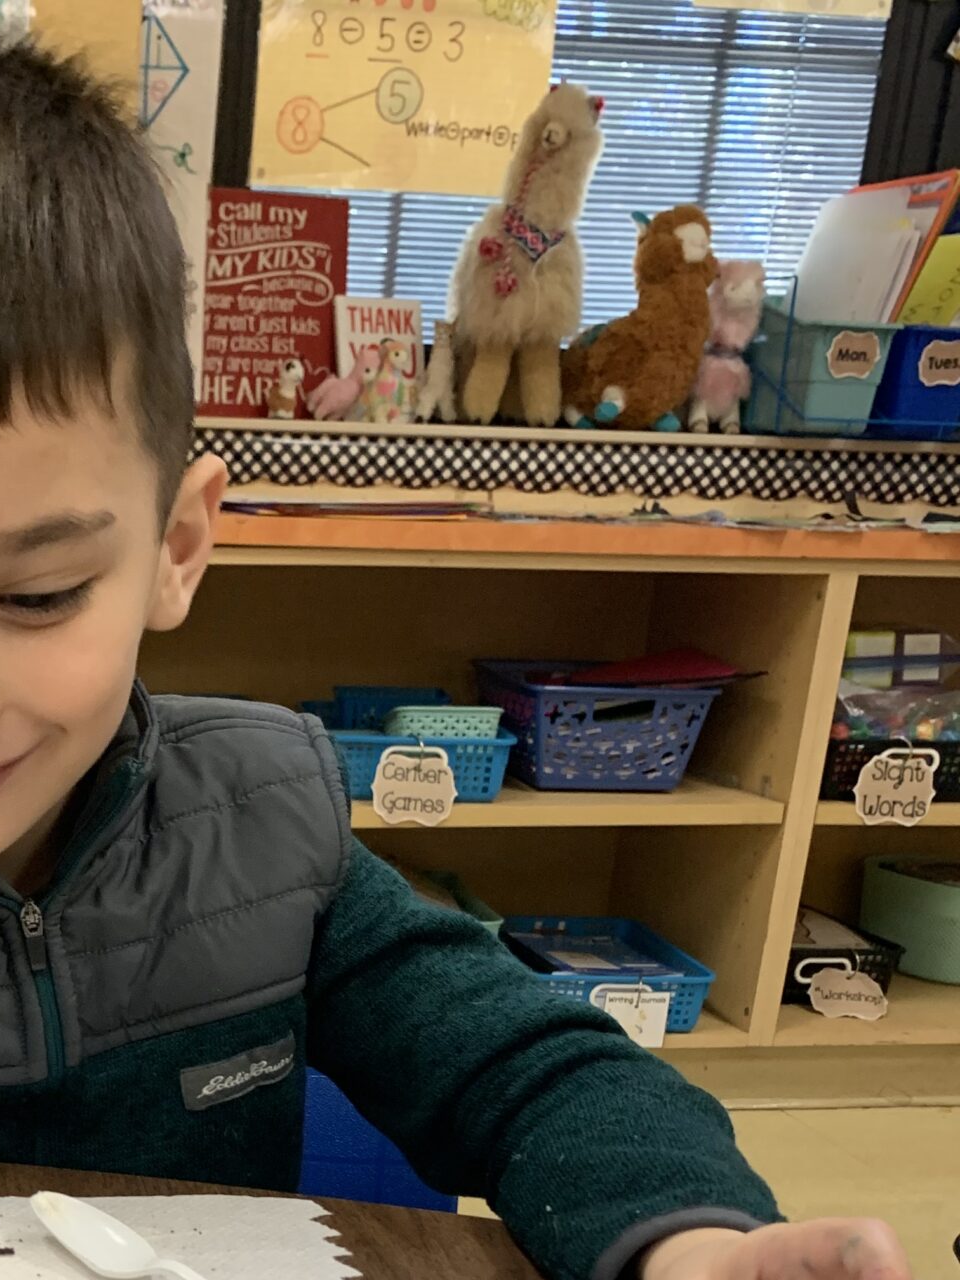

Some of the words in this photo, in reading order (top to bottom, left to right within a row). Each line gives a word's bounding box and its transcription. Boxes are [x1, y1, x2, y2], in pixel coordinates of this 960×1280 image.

[311, 10, 327, 47] 8
[376, 17, 395, 52] 5
[443, 21, 466, 62] 3
[388, 80, 411, 117] 5
[291, 104, 311, 146] 8
[219, 202, 262, 221] call
[269, 206, 308, 229] my
[208, 252, 252, 280] MY
[290, 315, 321, 336] kids
[346, 304, 417, 335] THANK
[230, 335, 269, 353] class
[202, 375, 280, 407] HEAR
[382, 761, 449, 785] Center
[871, 759, 926, 790] Sight
[381, 791, 445, 815] Games
[862, 794, 927, 818] Words
